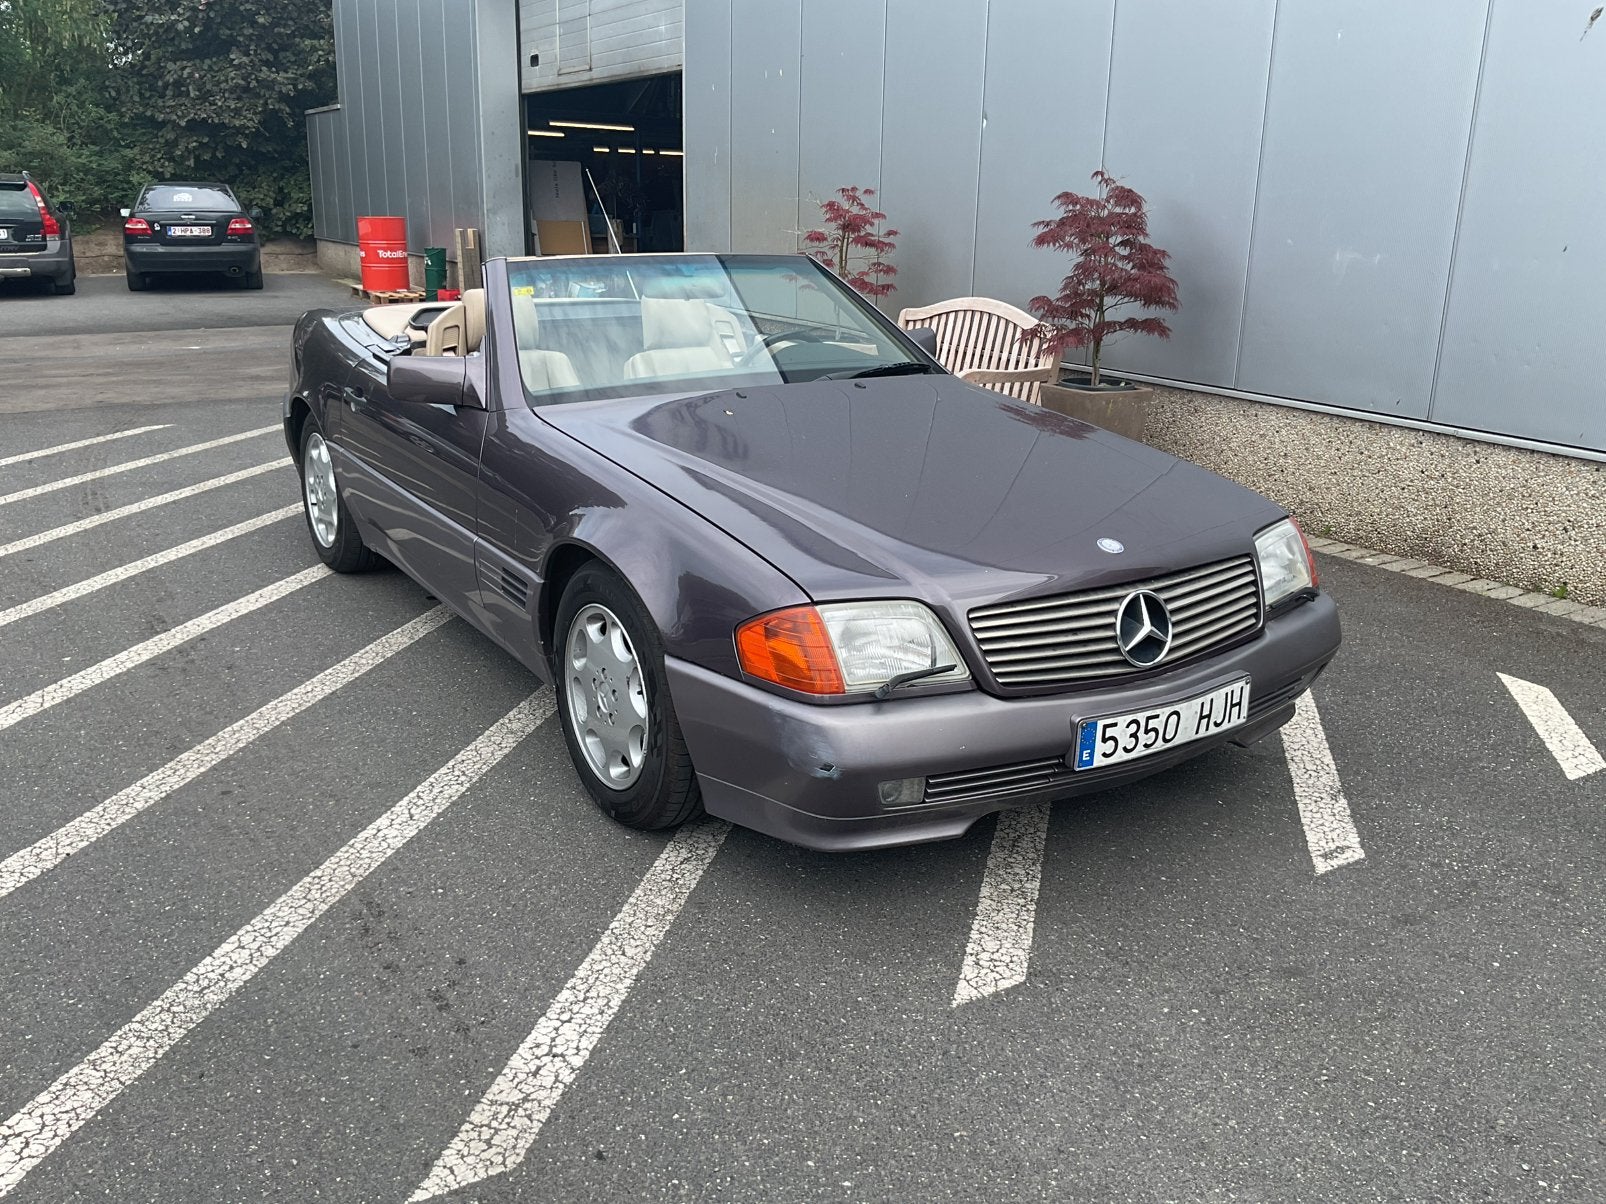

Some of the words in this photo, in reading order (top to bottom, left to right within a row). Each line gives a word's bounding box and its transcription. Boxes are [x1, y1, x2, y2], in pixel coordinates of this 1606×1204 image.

[1100, 710, 1180, 759] 5350
[1195, 685, 1244, 735] HJH
[1082, 749, 1091, 761] E
